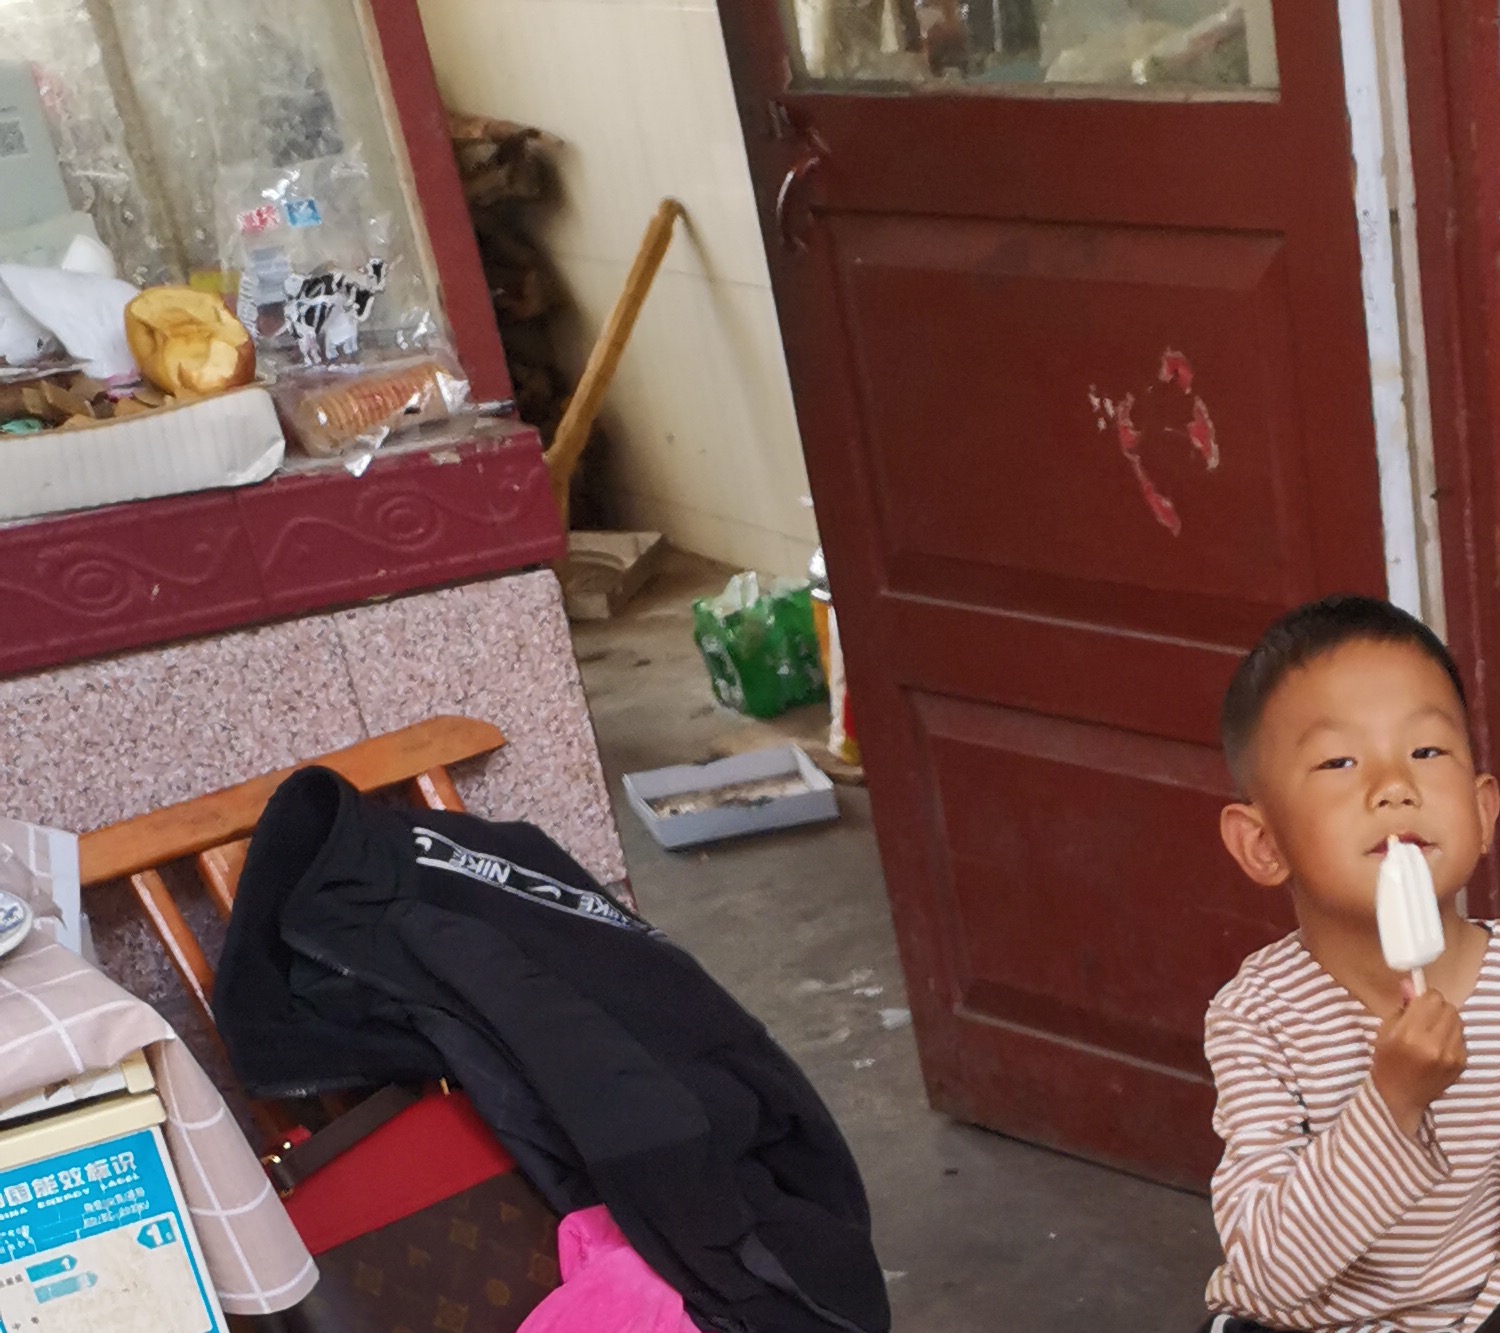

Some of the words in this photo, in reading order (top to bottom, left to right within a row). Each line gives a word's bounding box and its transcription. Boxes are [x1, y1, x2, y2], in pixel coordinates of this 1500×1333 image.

[0, 1151, 137, 1208] 国能效标识
